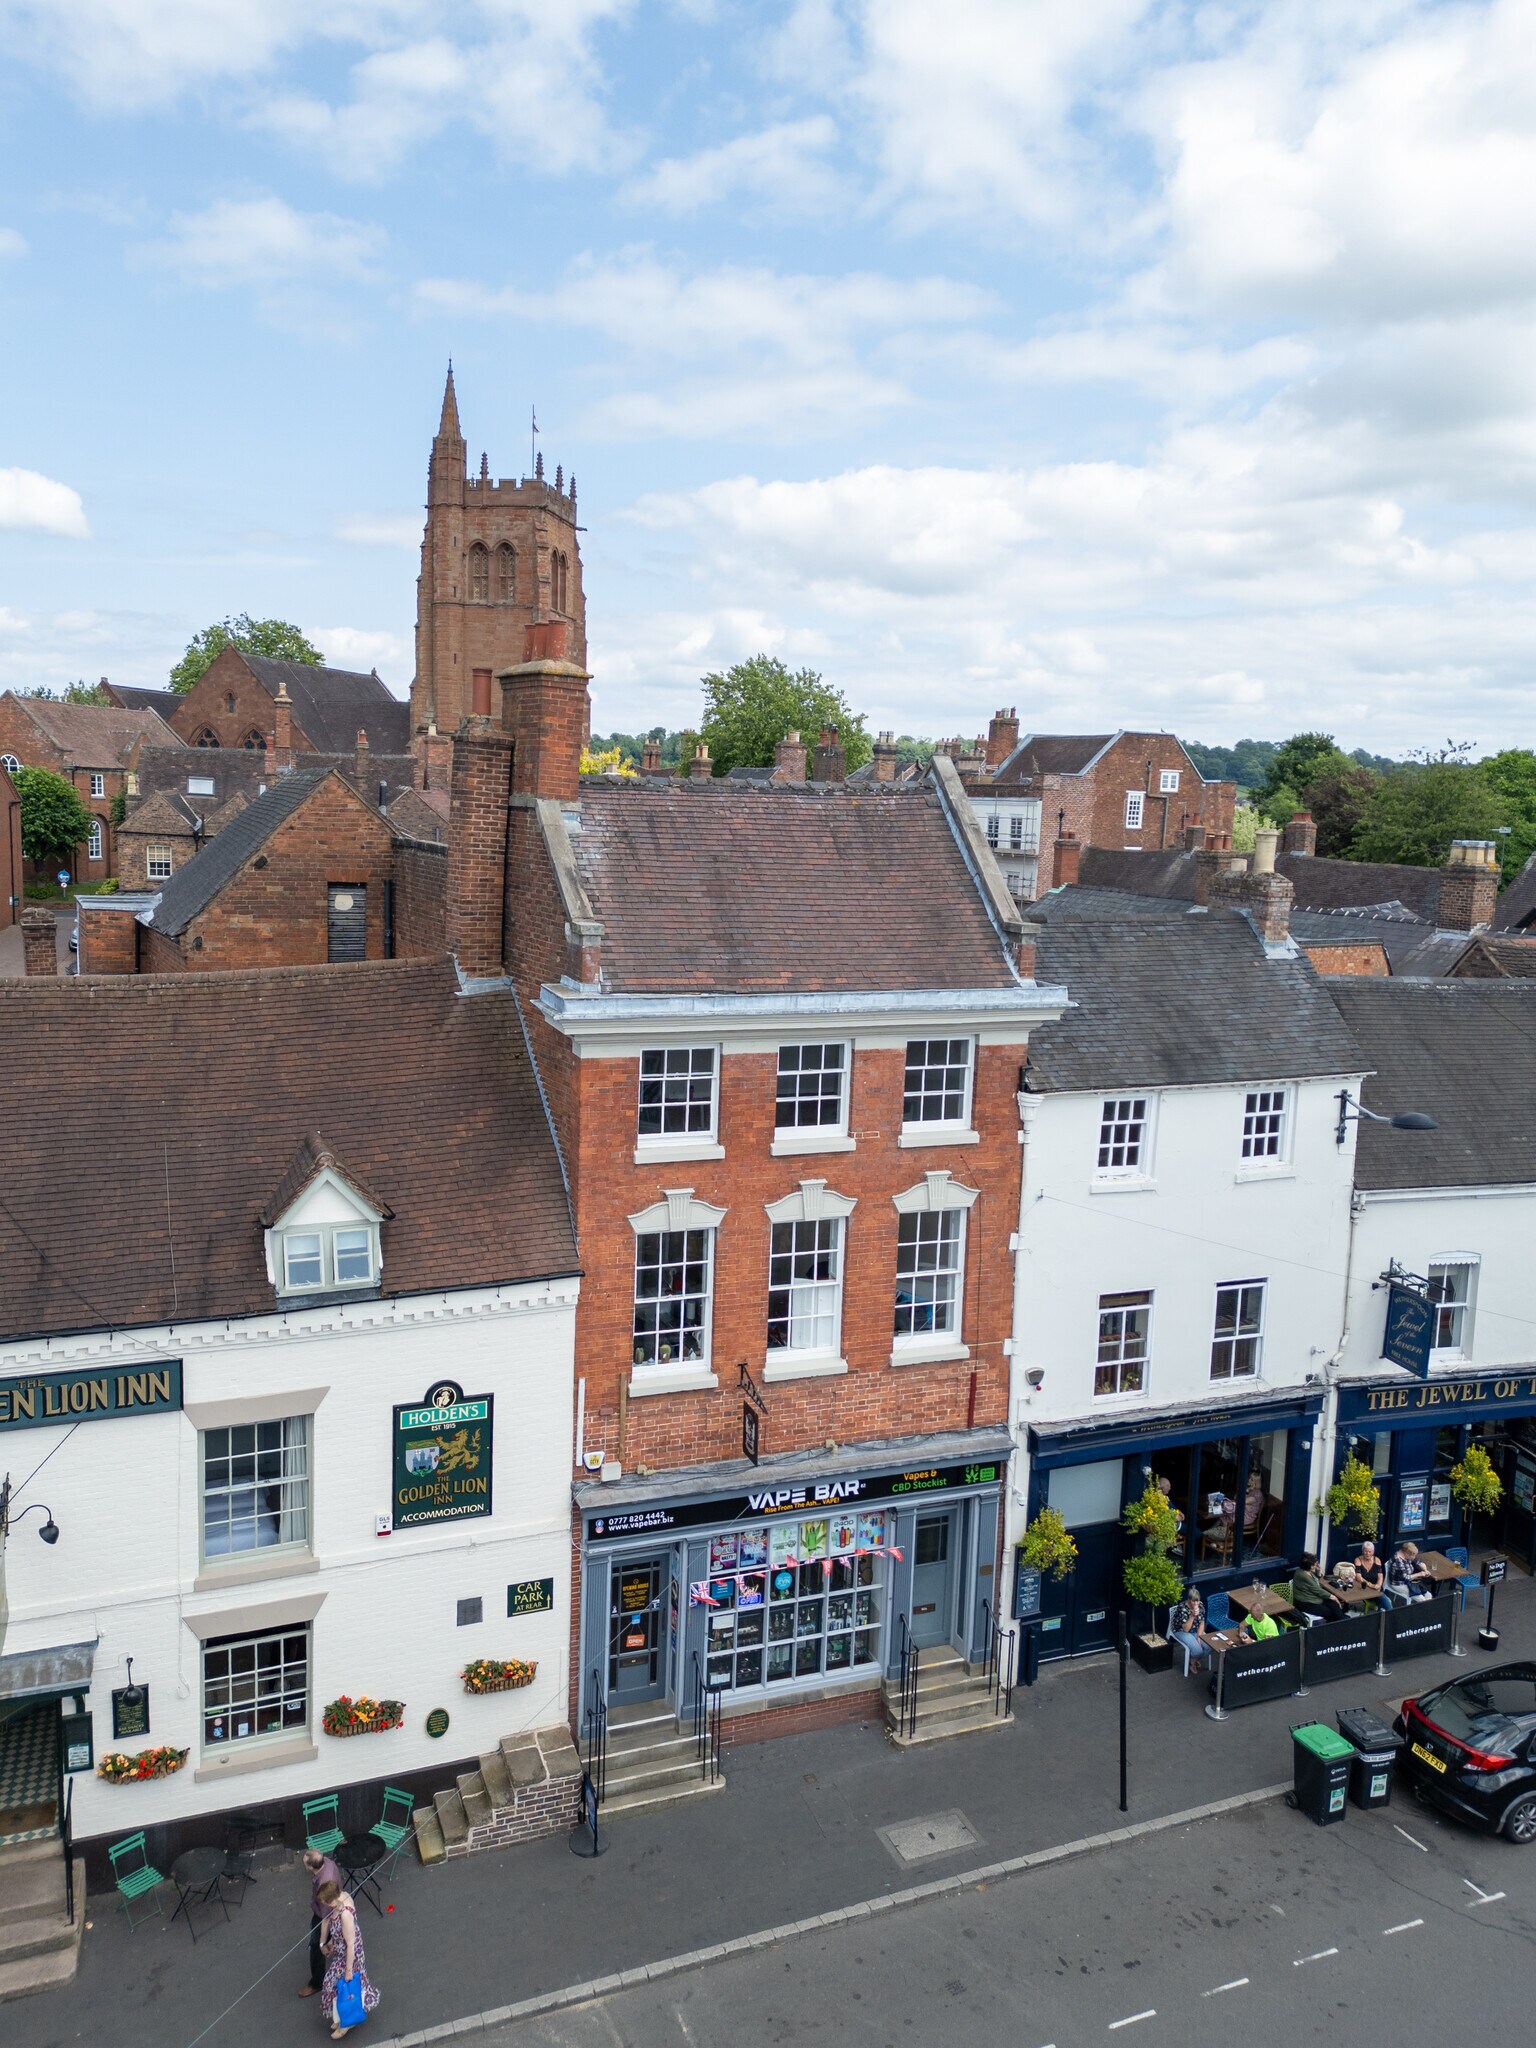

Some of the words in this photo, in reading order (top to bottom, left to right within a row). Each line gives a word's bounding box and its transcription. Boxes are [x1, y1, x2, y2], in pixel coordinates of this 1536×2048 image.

[1394, 1296, 1428, 1318] WETHERSPOON
[1392, 1314, 1426, 1332] Jewel
[1390, 1334, 1423, 1354] Severn
[18, 1379, 46, 1389] THE
[44, 1379, 108, 1416] LION
[117, 1370, 170, 1406] INN
[1367, 1389, 1409, 1410] THE
[1416, 1382, 1487, 1408] JEWEL
[1494, 1380, 1521, 1398] OF
[409, 1405, 478, 1425] HOLDEN'S
[904, 1470, 928, 1481] Vapes
[930, 1469, 938, 1477] &
[398, 1482, 449, 1505] GOLDEN
[454, 1477, 488, 1494] LION
[892, 1482, 911, 1492] CBD
[913, 1478, 947, 1490] Stockist
[434, 1495, 453, 1504] INN
[748, 1488, 806, 1510] VAPE
[814, 1480, 860, 1500] BAR
[400, 1504, 484, 1522] ACCOMMODATION
[608, 1516, 628, 1526] 0777
[629, 1514, 644, 1522] 820
[645, 1512, 665, 1520] 4442
[608, 1516, 674, 1532] www.vapebar.biz
[518, 1582, 542, 1594] CAR
[514, 1591, 544, 1604] PARK
[526, 1602, 542, 1610] REAR
[1396, 1624, 1442, 1638] wetherspoon
[1316, 1641, 1366, 1656] wetherspoon
[1236, 1661, 1286, 1678] wetherspoon
